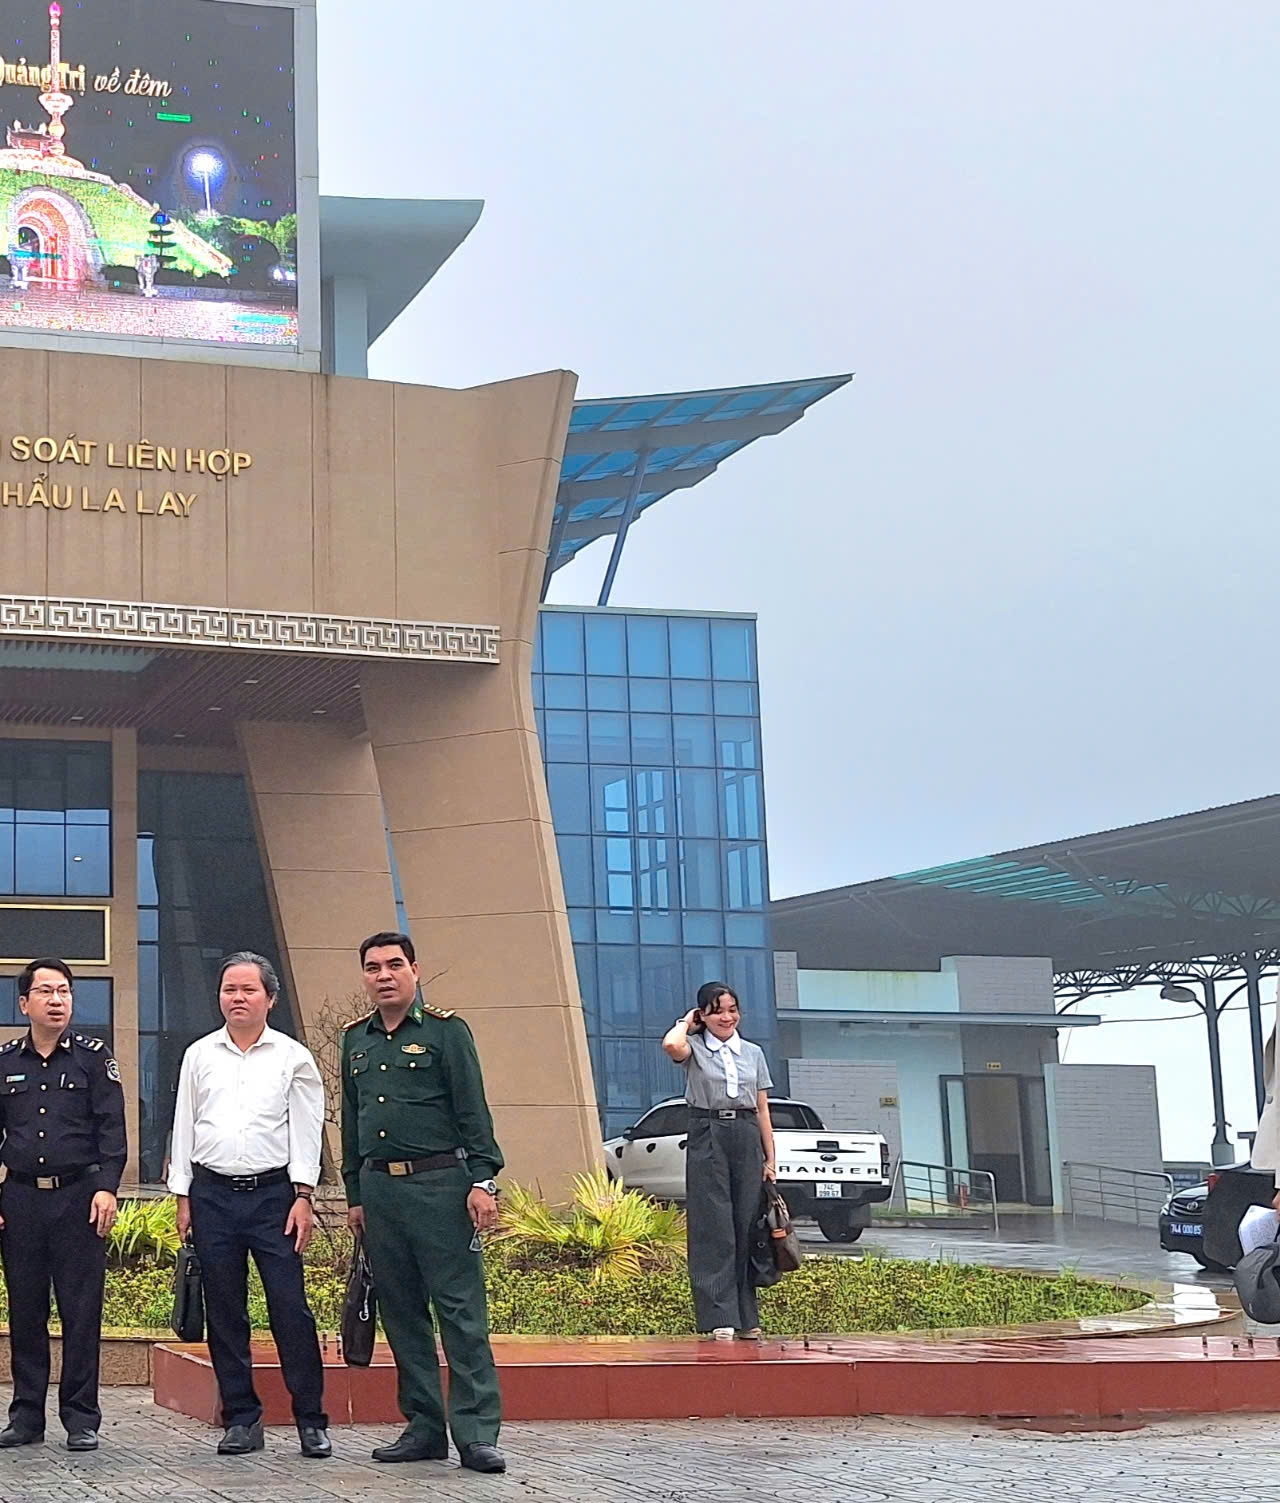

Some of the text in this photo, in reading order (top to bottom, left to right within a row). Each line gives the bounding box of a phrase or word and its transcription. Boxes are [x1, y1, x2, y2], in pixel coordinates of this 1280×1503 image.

[57, 62, 86, 97] Trị
[94, 66, 121, 93] về
[124, 69, 172, 97] đêm
[10, 434, 97, 466] SOÁT
[107, 439, 176, 471] LIÊN
[186, 448, 252, 481] HỢP
[82, 486, 126, 513] LA
[136, 490, 197, 518] LAY
[778, 1165, 879, 1175] RANGER
